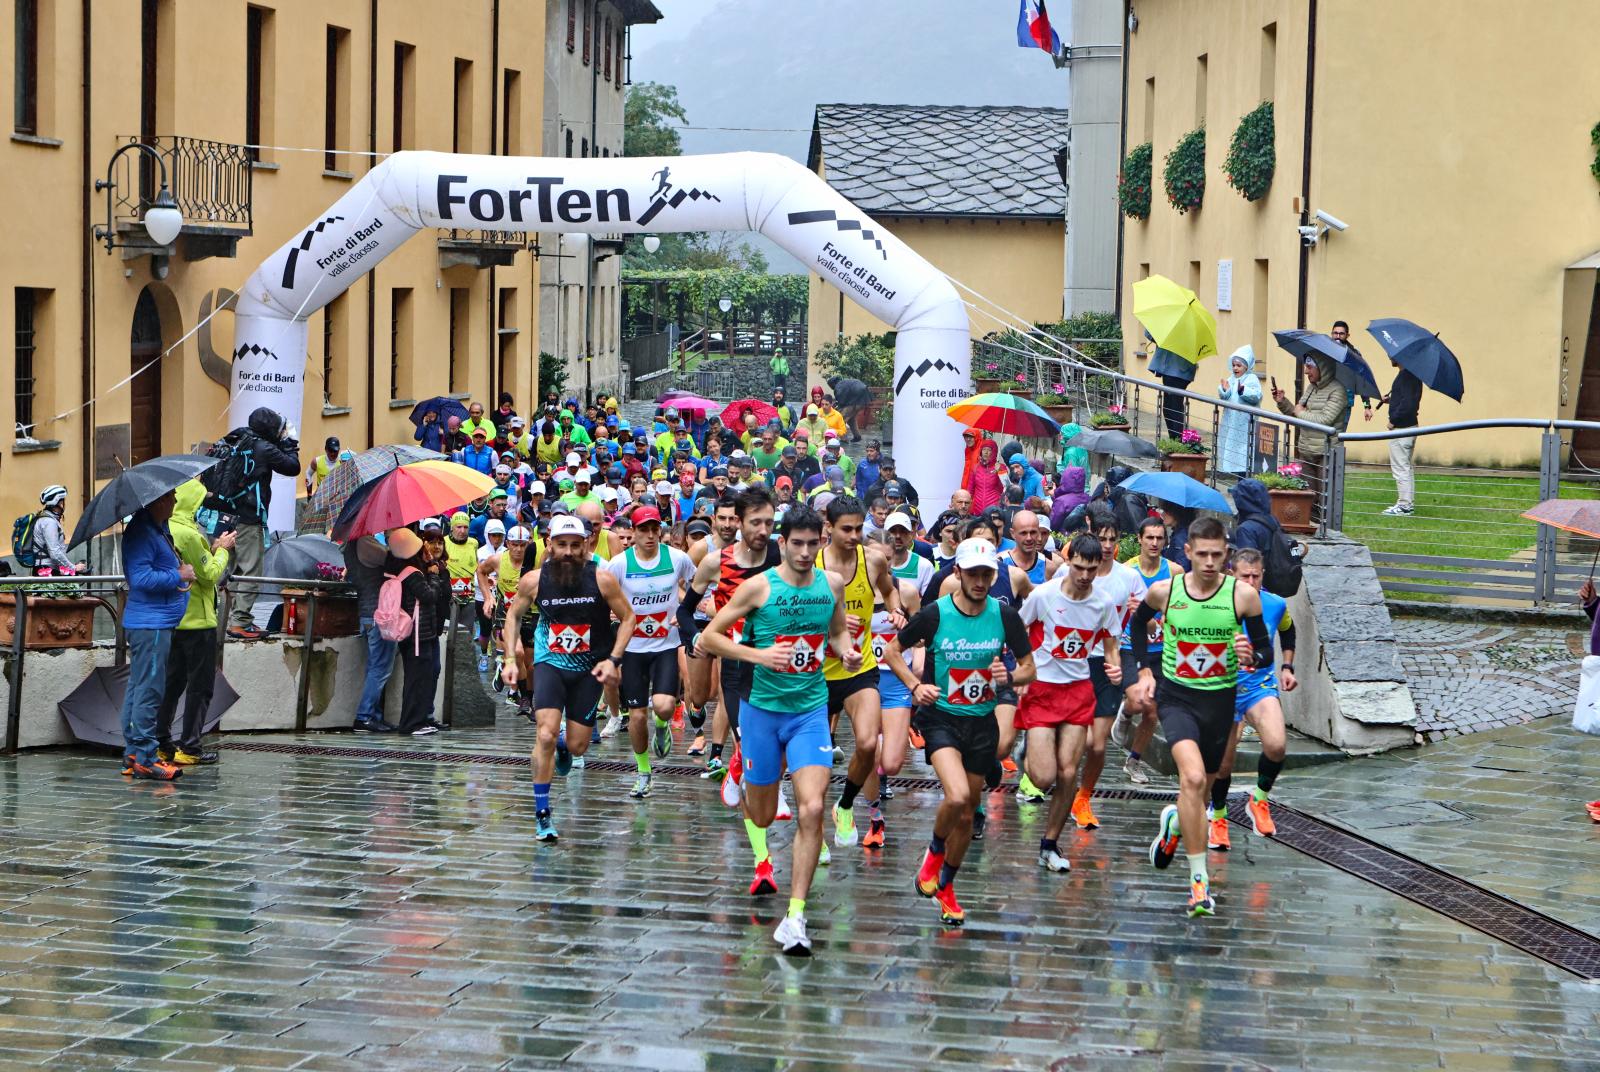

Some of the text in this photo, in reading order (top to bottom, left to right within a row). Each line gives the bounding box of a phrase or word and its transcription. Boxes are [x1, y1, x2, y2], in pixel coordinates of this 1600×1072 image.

[437, 175, 631, 223] ForTen
[316, 218, 383, 269] Forte di Bard
[328, 240, 379, 277] valle d'aosta
[817, 255, 870, 299] valle d'aosta
[822, 242, 896, 300] Forte di Bard
[262, 373, 272, 381] di
[274, 373, 295, 383] Bard
[920, 388, 946, 398] Forte
[948, 389, 957, 398] di
[920, 400, 940, 409] valle
[551, 596, 595, 605] SCARPA
[632, 593, 672, 606] Cetilar
[846, 600, 864, 610] TTA
[645, 624, 654, 634] 8
[555, 636, 583, 649] 272
[1060, 641, 1086, 654] 157
[794, 651, 816, 667] 85
[1196, 658, 1206, 672] 7
